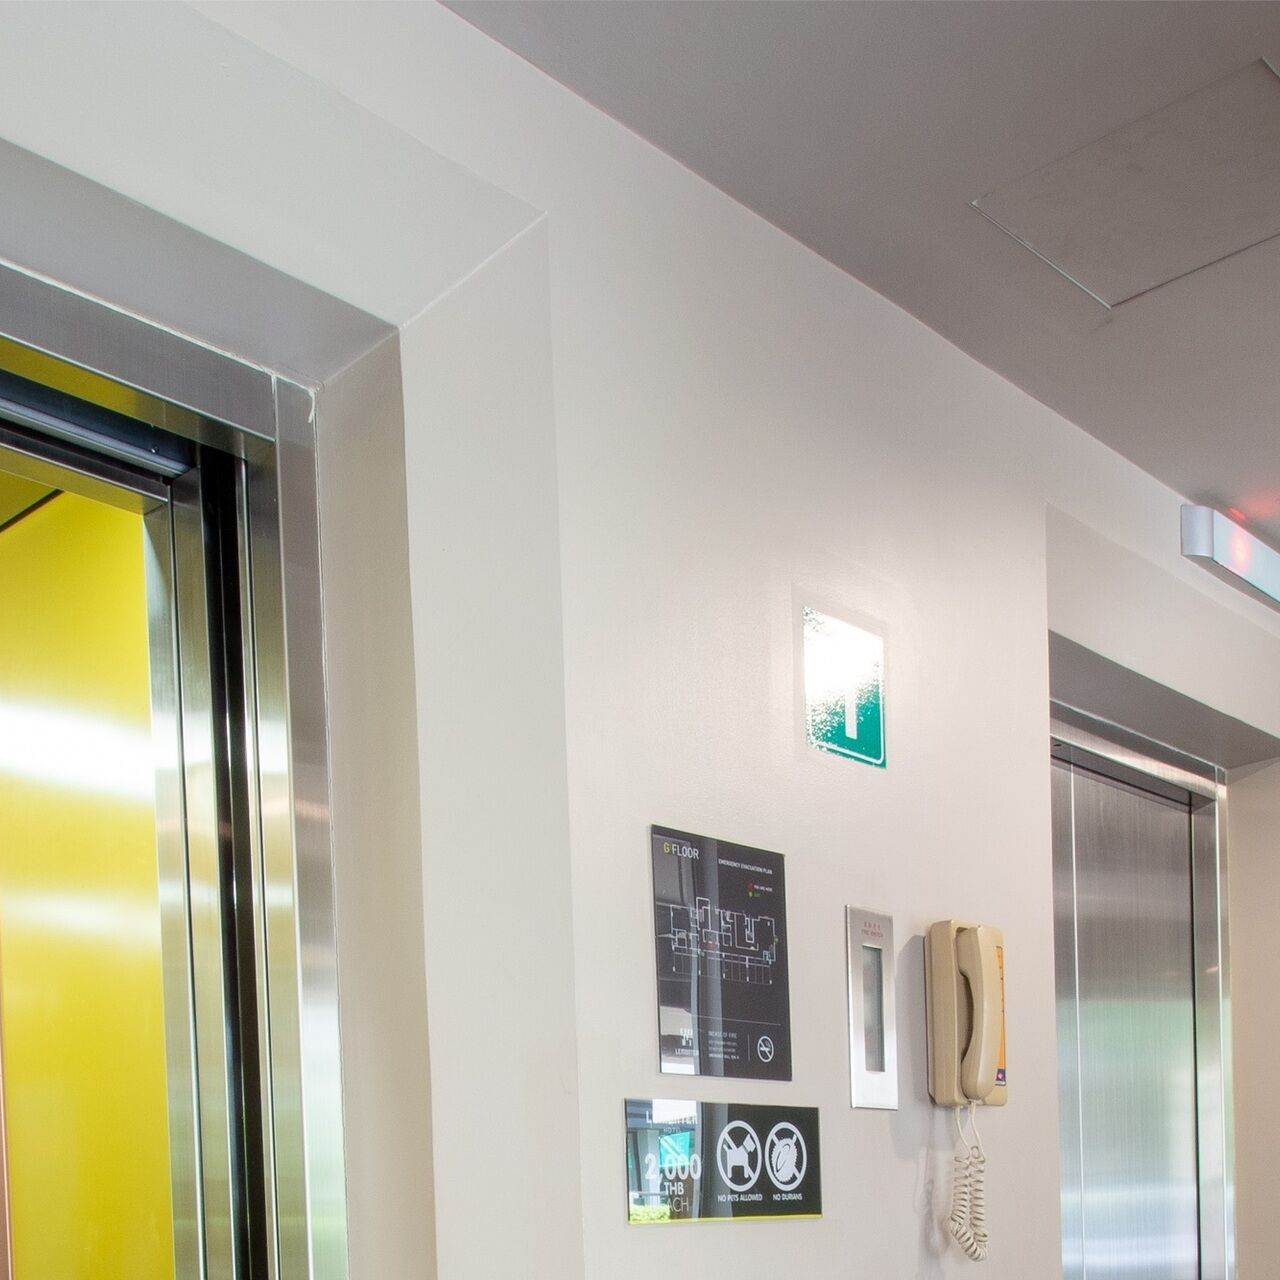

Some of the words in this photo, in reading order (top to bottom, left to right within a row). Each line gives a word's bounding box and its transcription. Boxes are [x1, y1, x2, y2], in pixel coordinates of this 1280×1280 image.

[663, 842, 670, 854] G
[672, 844, 699, 860] FLOOR
[718, 858, 740, 868] EMERGENCY
[763, 867, 773, 875] PLAN
[645, 1153, 702, 1184] 2,000
[664, 1182, 684, 1195] THB
[718, 1194, 727, 1202] NO
[727, 1194, 739, 1202] PETS
[740, 1193, 763, 1201] ALLOWED
[773, 1193, 781, 1201] NO
[782, 1193, 802, 1201] DURIANS
